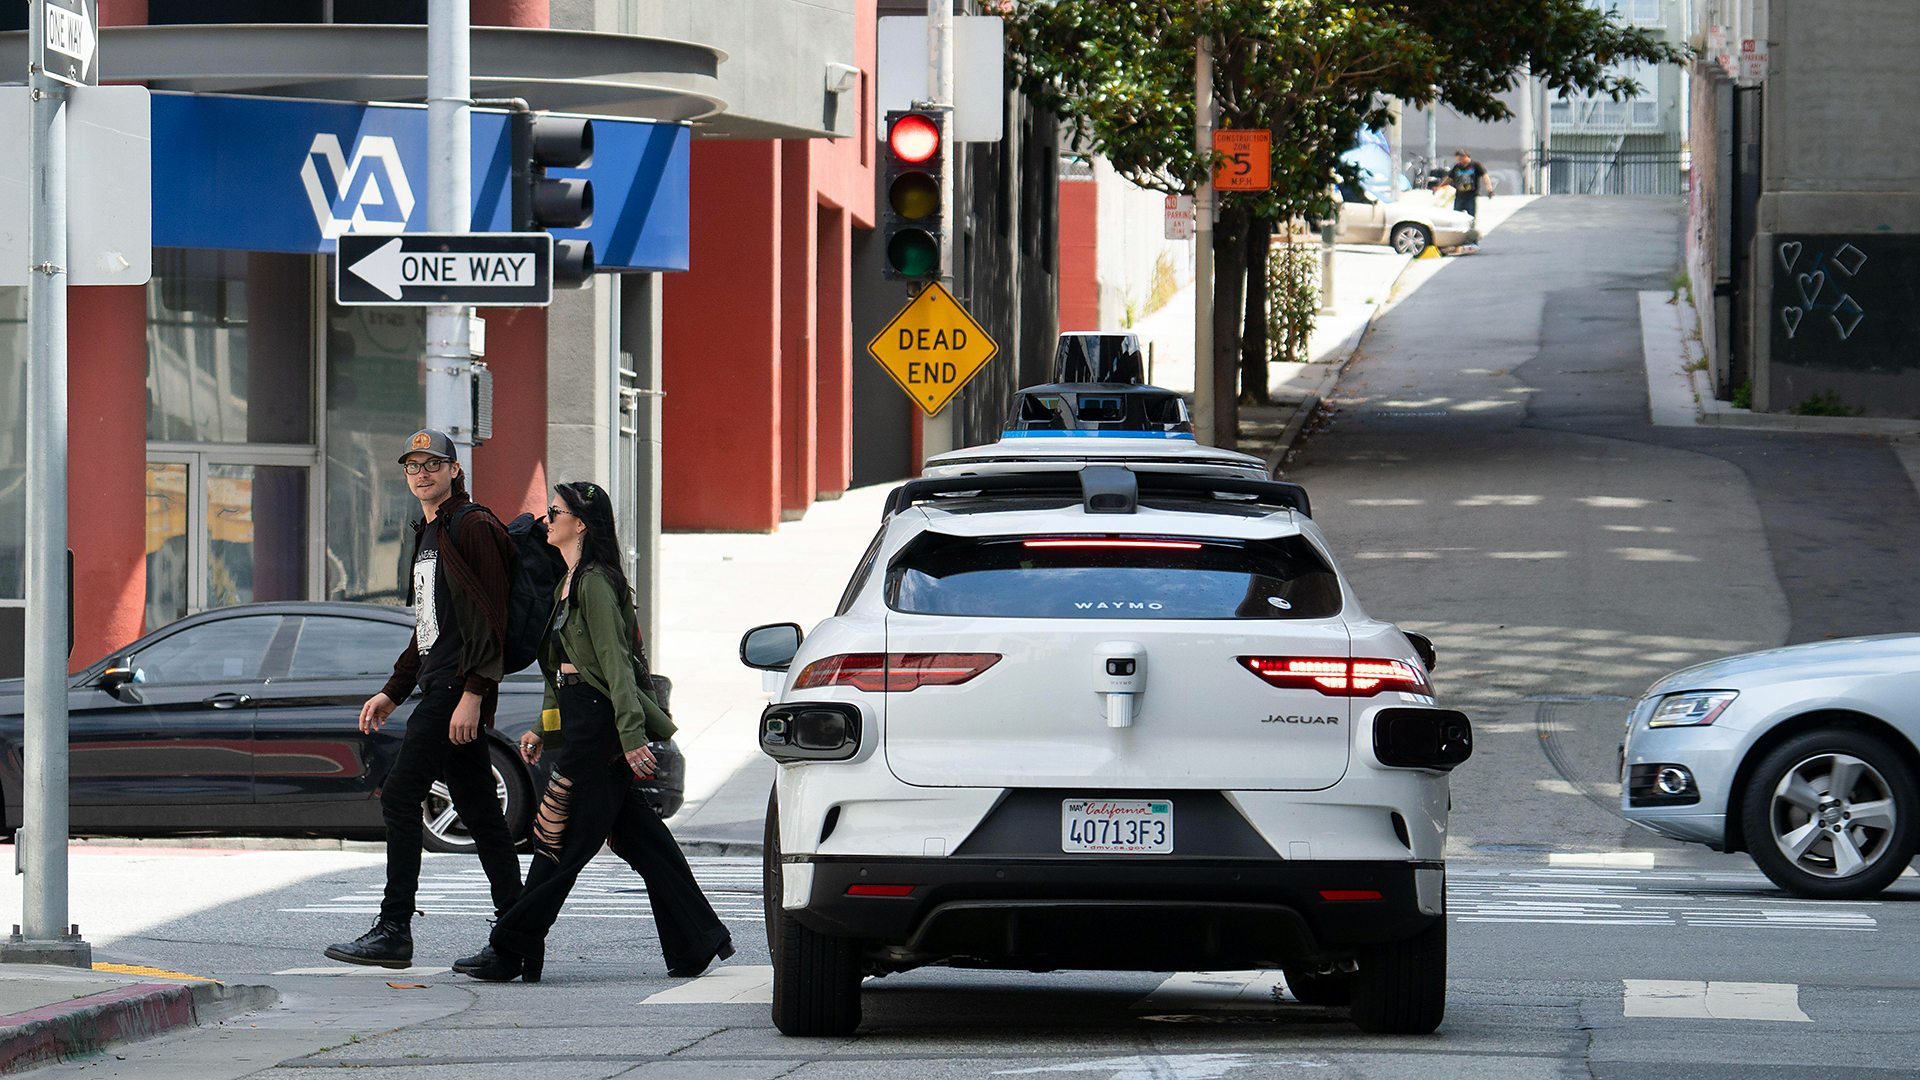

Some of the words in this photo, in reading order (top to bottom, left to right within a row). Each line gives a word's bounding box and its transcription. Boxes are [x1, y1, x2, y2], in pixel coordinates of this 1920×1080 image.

[49, 9, 66, 48] ONE
[67, 15, 83, 55] WAY
[1217, 134, 1268, 142] CONSTRUCTION
[1233, 143, 1251, 151] ZONE
[1233, 152, 1251, 176] 5
[300, 133, 416, 240] VA
[1166, 197, 1177, 208] NO
[1167, 211, 1192, 219] PARKING
[401, 256, 457, 282] ONE
[469, 256, 527, 282] WAY
[899, 328, 967, 350] DEAD
[908, 362, 957, 384] END
[1074, 602, 1164, 610] WAYMO
[1261, 714, 1340, 725] JAGUAR
[1069, 804, 1083, 812] MAY
[1085, 802, 1152, 819] California
[1069, 819, 1165, 845] 40713F3
